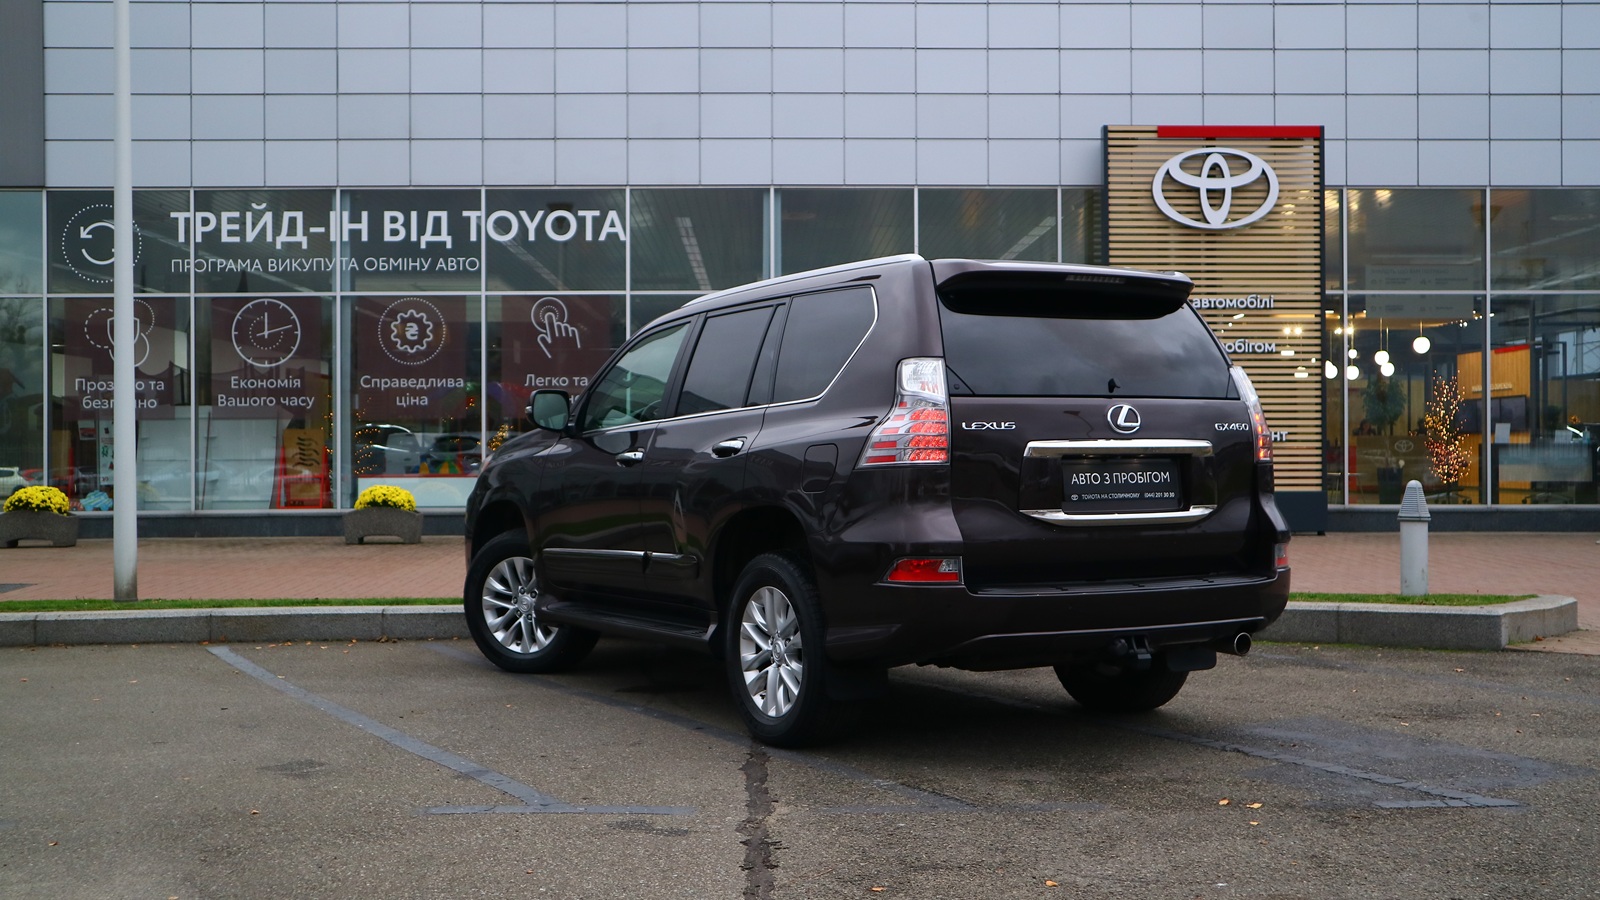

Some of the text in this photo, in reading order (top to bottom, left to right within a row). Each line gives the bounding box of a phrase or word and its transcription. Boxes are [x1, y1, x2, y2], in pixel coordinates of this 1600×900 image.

[170, 203, 627, 249] ТРЕЙД-ІН ВІД TOYOTA
[172, 257, 480, 273] ПРОГРАМА ВИКУПУ ТА ОБМІНУ АВТО
[1192, 294, 1275, 309] автомобілі
[1221, 339, 1276, 353] обігом
[75, 378, 165, 394] Прозо та
[230, 375, 301, 389] Економія
[360, 375, 464, 390] Справедлива
[524, 373, 588, 387] Легко та
[217, 395, 315, 409] Вашого часу
[396, 394, 428, 407] ціна
[961, 421, 1017, 431] LEXUS
[1071, 472, 1101, 485] АВТО
[1113, 471, 1171, 484] ПРОБІГОМ
